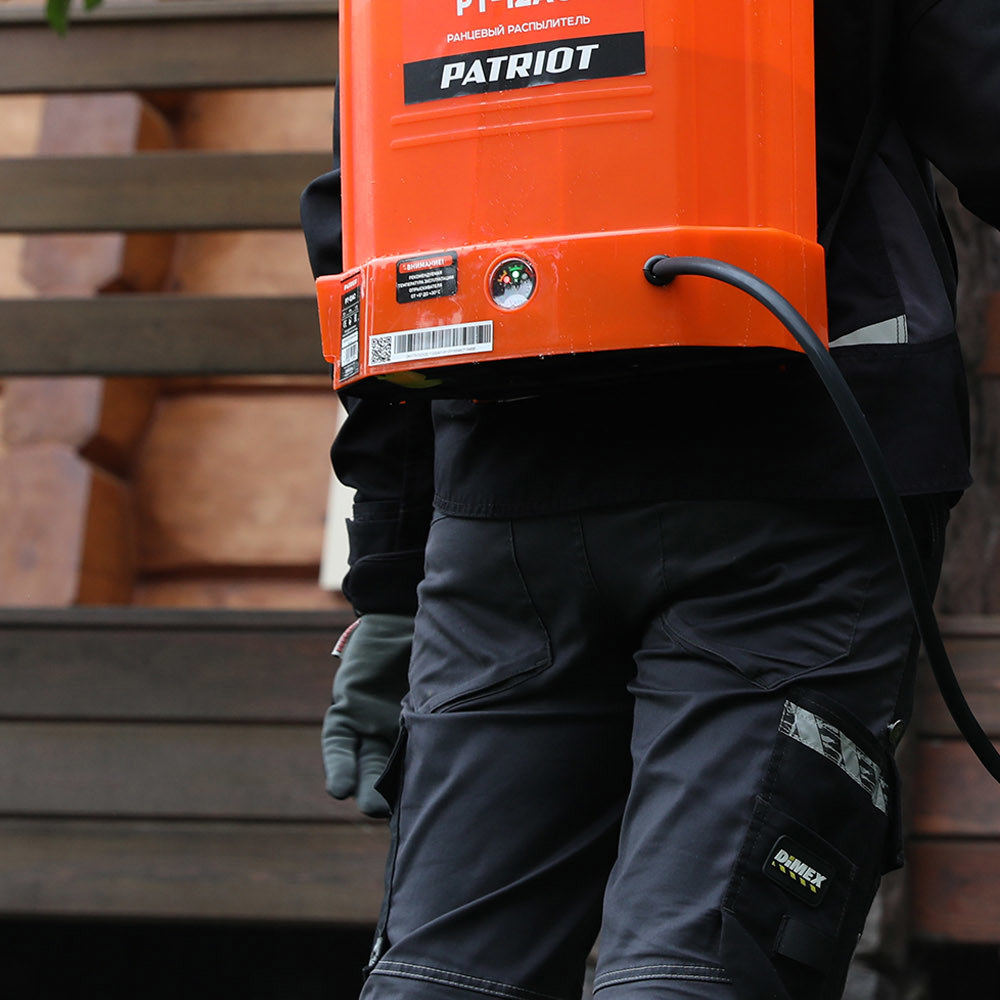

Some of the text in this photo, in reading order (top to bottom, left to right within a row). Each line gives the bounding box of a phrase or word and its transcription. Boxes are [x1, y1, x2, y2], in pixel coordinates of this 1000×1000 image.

[447, 15, 591, 43] РАНЦЕВЫЙ РАСПЫЛИТЕЛЬ
[440, 43, 600, 89] PATRIOT
